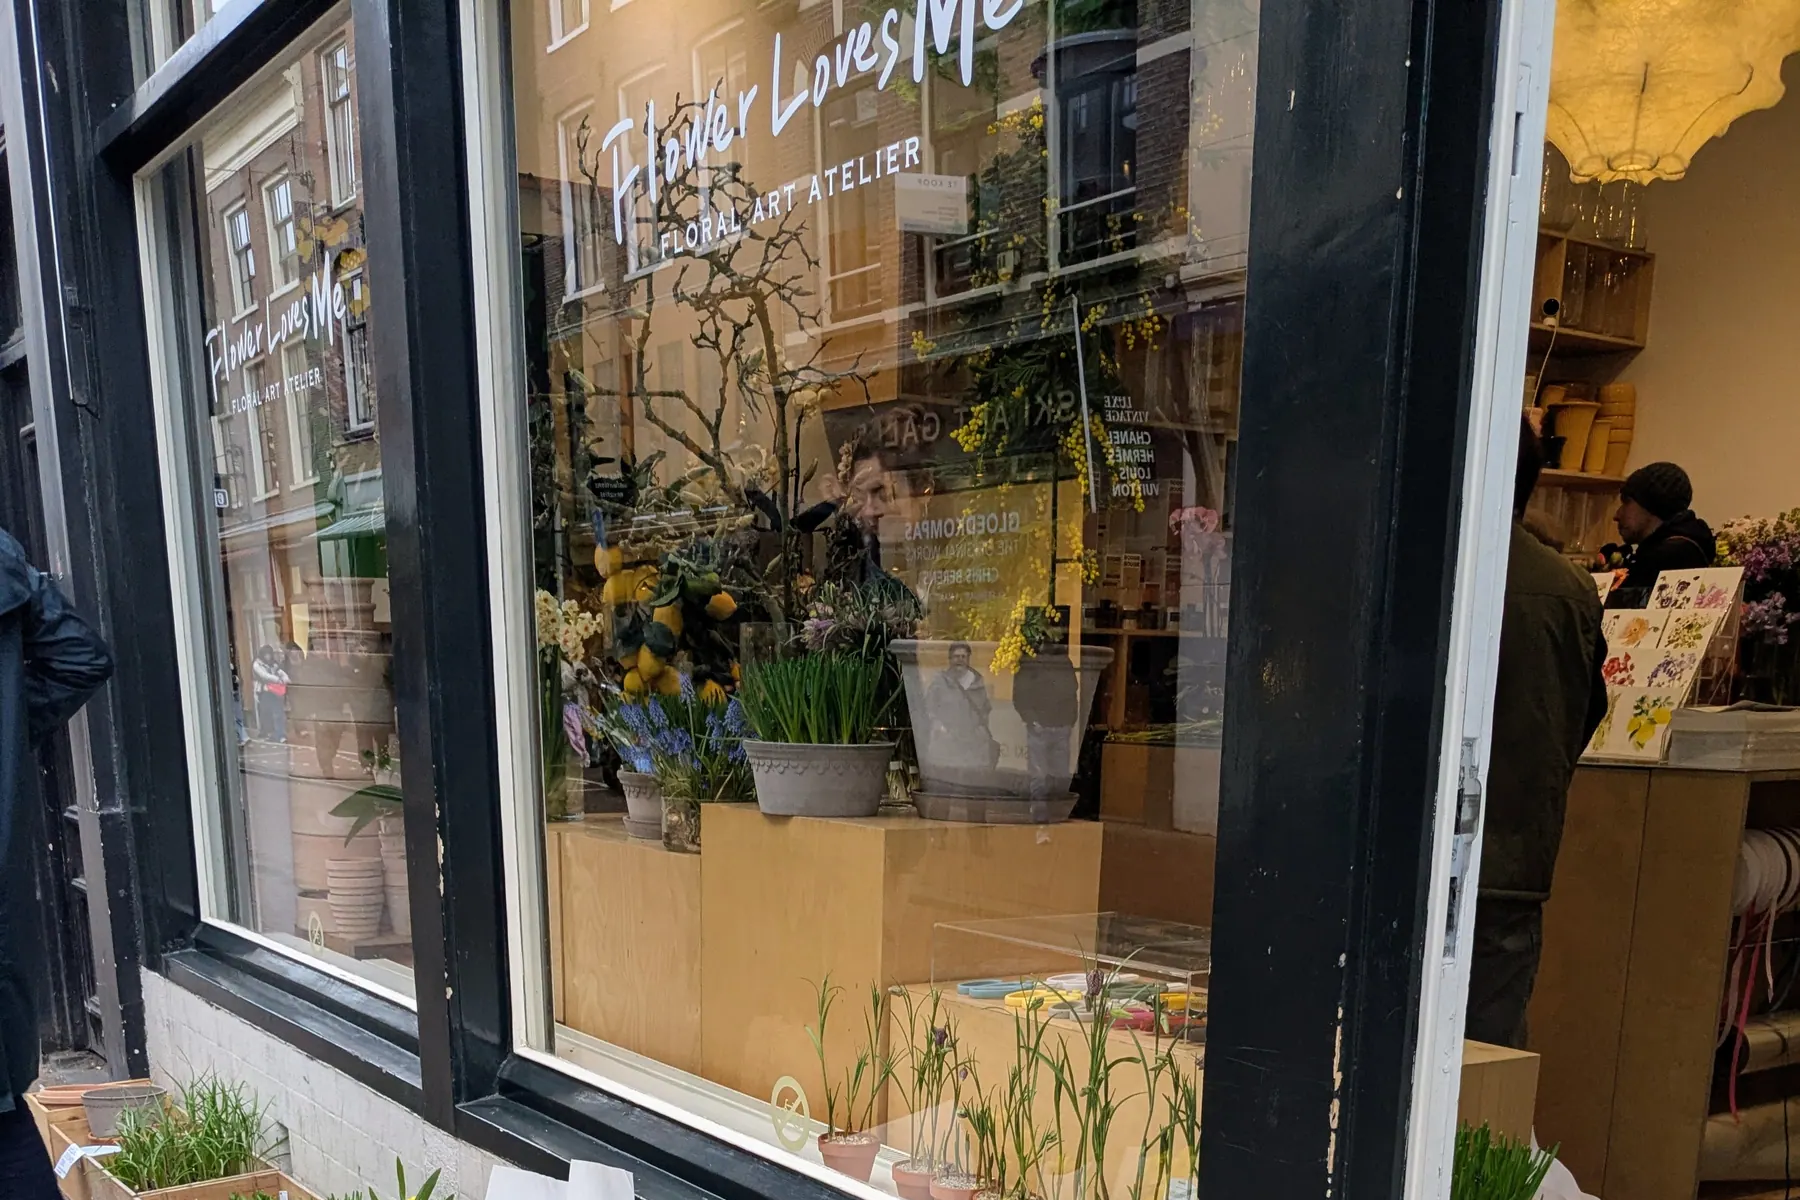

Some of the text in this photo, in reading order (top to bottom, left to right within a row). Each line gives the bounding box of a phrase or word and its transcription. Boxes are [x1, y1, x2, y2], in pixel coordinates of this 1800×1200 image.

[602, 83, 758, 246] Flower
[770, 8, 898, 137] Loves
[660, 136, 921, 258] FLORAL ART ATELIER
[205, 250, 346, 403] Flower Loves Me
[231, 367, 321, 415] FLORAL ART ATELIER
